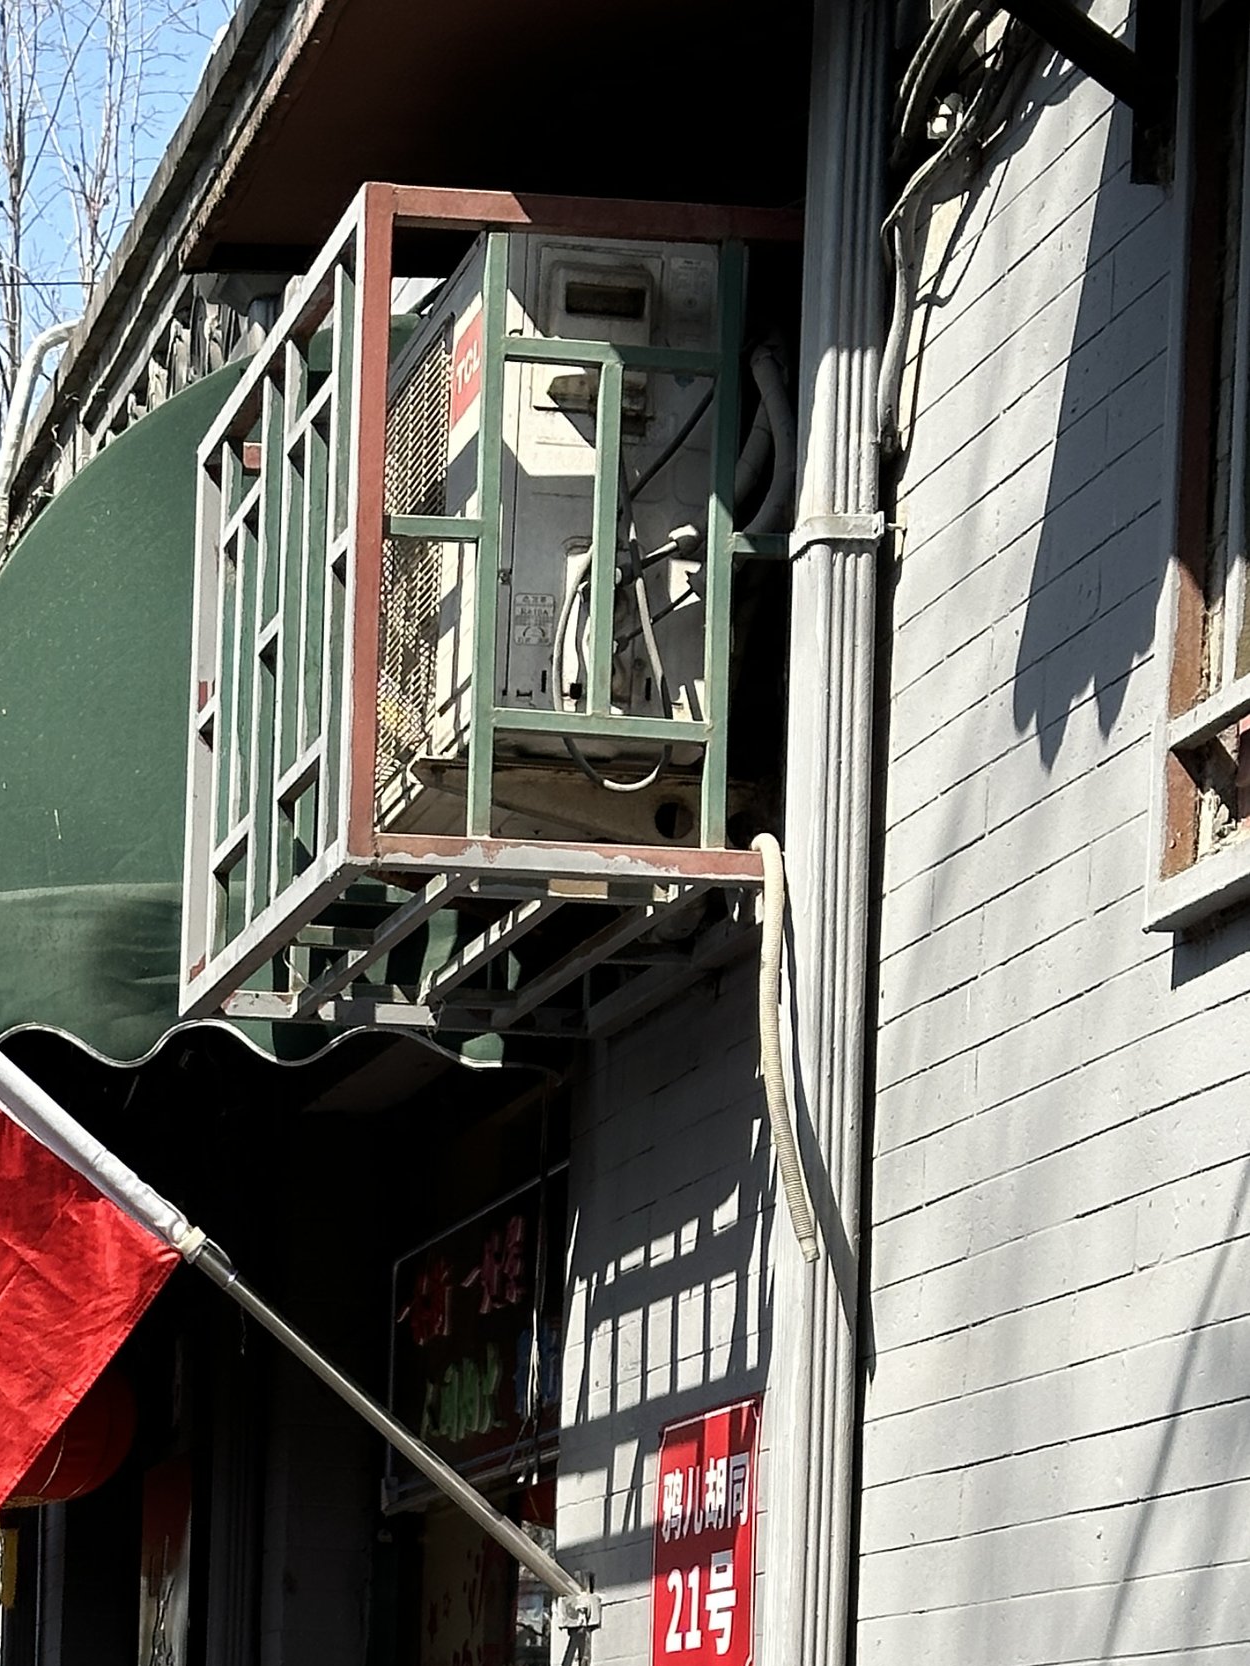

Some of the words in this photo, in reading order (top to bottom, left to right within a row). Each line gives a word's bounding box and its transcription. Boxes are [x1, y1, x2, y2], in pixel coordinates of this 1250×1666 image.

[456, 340, 481, 395] TCL
[661, 1451, 750, 1543] 鸦儿胡同
[665, 1549, 737, 1655] 21号
